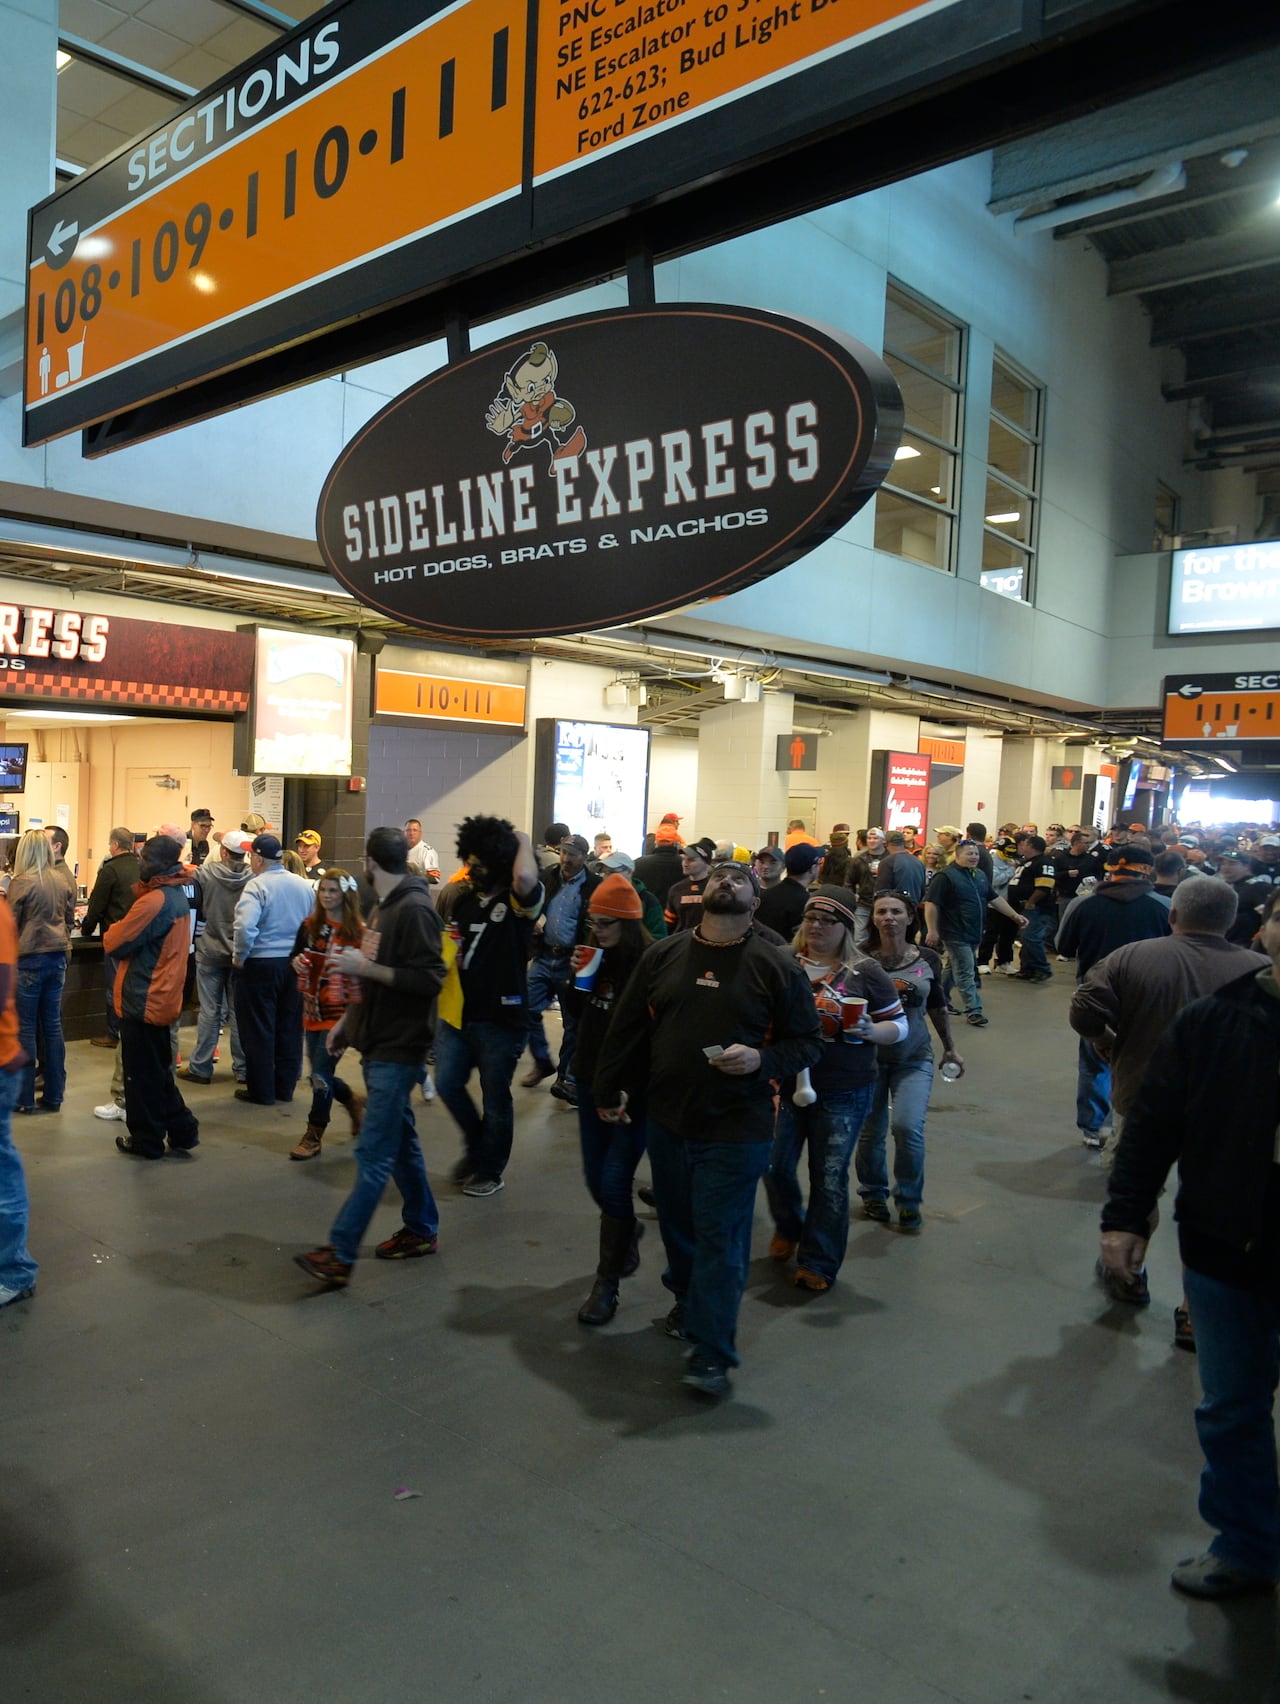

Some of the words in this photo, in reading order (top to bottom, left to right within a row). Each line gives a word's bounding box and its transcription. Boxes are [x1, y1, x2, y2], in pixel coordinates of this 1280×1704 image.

[557, 37, 583, 68] SE
[590, 0, 687, 52] Escalato
[559, 0, 607, 36] PNC
[556, 67, 587, 100] NE
[594, 18, 697, 82] Escalator
[703, 4, 729, 27] to
[578, 65, 667, 120] 622-623;
[680, 32, 726, 74] Bud
[735, 1, 801, 48] Light
[127, 22, 340, 191] SECTIONS
[577, 113, 625, 153] Ford
[631, 91, 690, 130] Zone
[342, 465, 538, 562] SIDELINE
[555, 400, 821, 526] EXPRESS
[373, 565, 417, 584] HOT
[423, 554, 493, 577] DOGS,
[500, 538, 588, 565] BRATS
[597, 533, 620, 549] &
[629, 508, 769, 545] NACHOS
[1183, 551, 1231, 576] for
[1234, 674, 1280, 689] SEC
[1042, 864, 1055, 876] 12
[463, 922, 488, 970] 7
